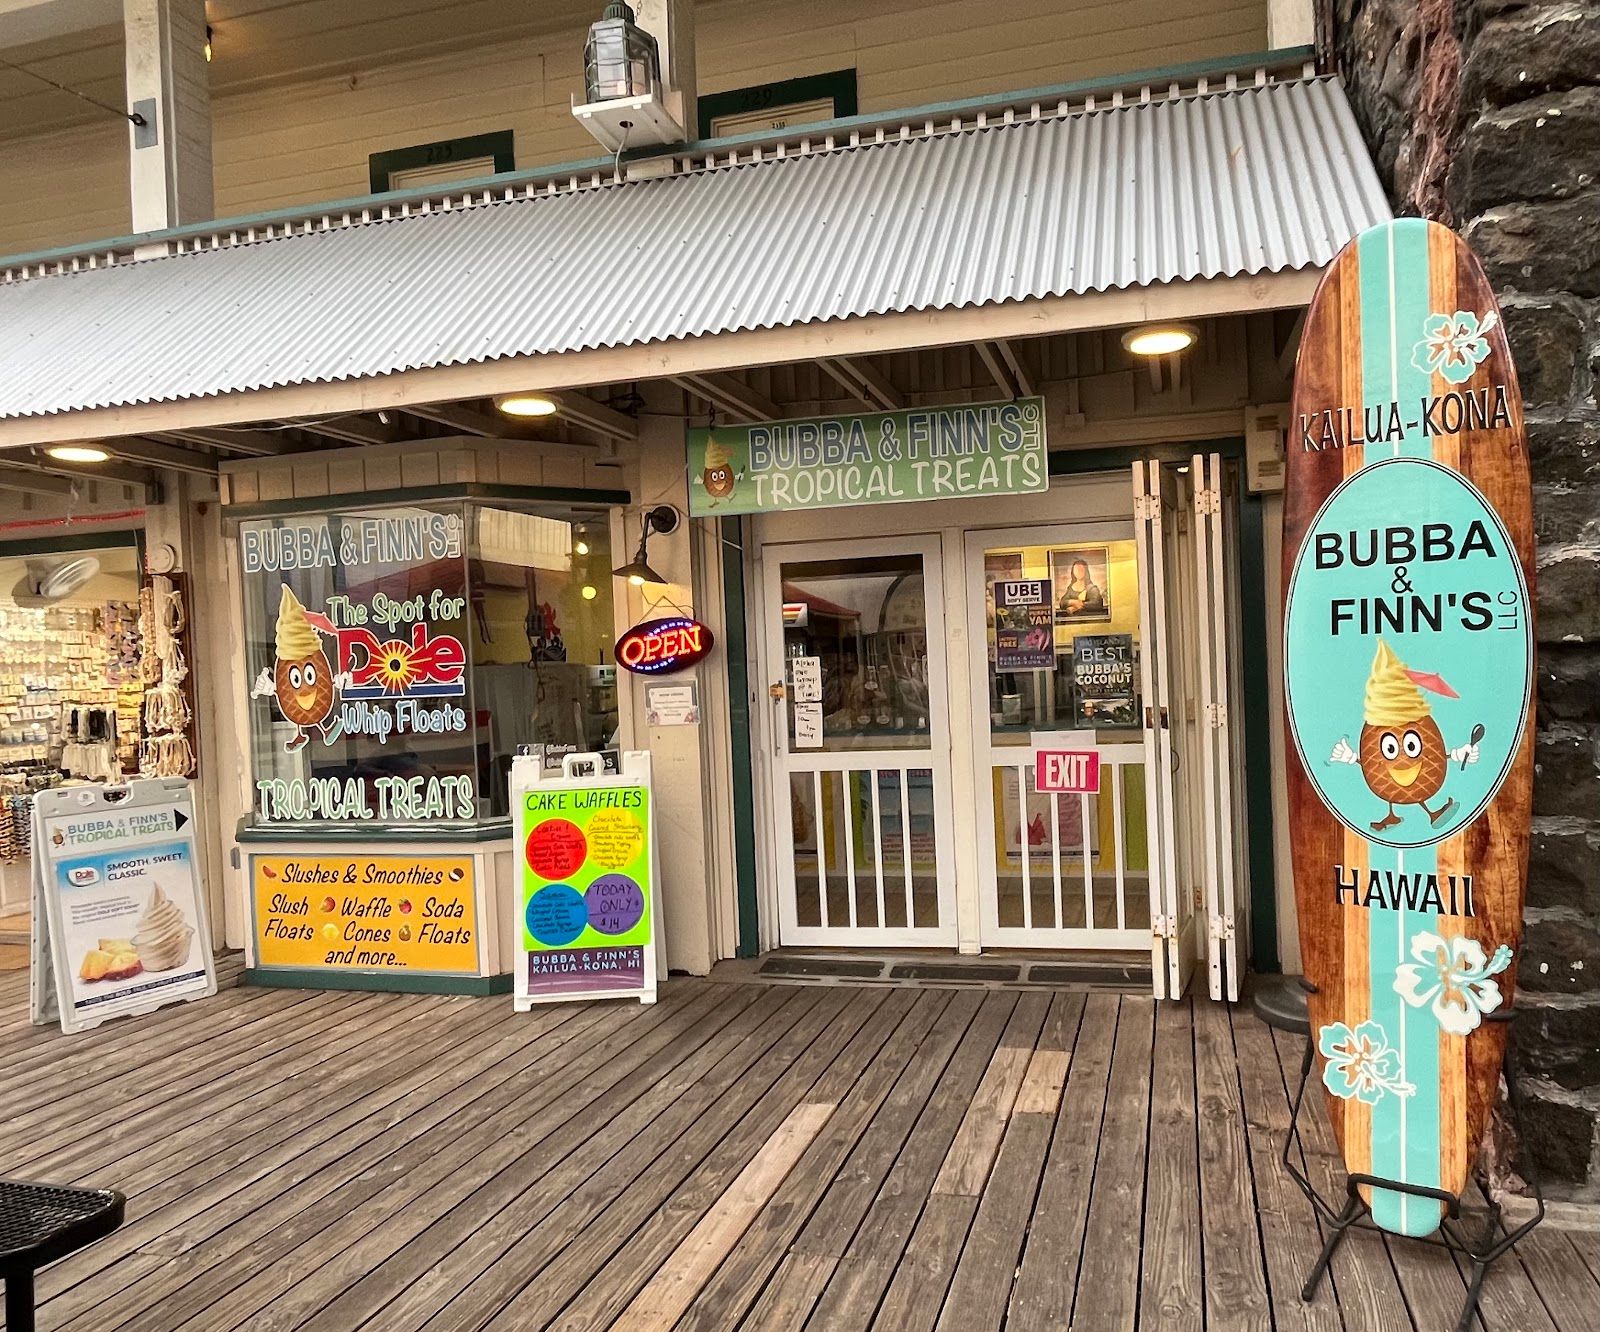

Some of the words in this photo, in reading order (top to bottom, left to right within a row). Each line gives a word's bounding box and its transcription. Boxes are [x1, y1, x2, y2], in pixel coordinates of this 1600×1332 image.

[1023, 404, 1041, 451] LLC
[1300, 385, 1513, 452] KAILUA-KONA
[749, 419, 873, 472] BUBBA
[877, 417, 902, 462] &
[908, 405, 1024, 460] FINN'S
[751, 464, 904, 506] TROPICAL
[911, 453, 1042, 495] TREATS
[243, 525, 338, 573] BUBBA
[340, 524, 359, 566] &
[361, 514, 449, 564] FINN'S
[1315, 520, 1498, 569] BUBBA
[1007, 583, 1041, 597] UBE
[1390, 566, 1414, 594] &
[326, 595, 369, 625] The
[371, 590, 424, 633] Spot
[428, 588, 465, 621] for
[1029, 616, 1051, 626] YAM
[1331, 591, 1493, 636] FINN'S
[1497, 590, 1518, 631] LLC
[338, 622, 467, 686] Dole
[621, 625, 702, 666] OPEN
[1081, 648, 1125, 661] BEST
[1076, 674, 1132, 686] COCONUT
[1077, 663, 1132, 675] BUBBA'S
[340, 704, 393, 744] Whip
[396, 699, 467, 734] Floats
[1045, 754, 1090, 788] EXIT
[257, 776, 374, 820] TROPICAL
[377, 774, 476, 820] TREATS
[526, 794, 568, 811] CAKE
[574, 790, 642, 809] WAFFLES
[67, 819, 113, 835] BUBBA
[118, 818, 125, 828] &
[128, 812, 168, 826] FINN'S
[69, 827, 130, 845] TROPICAL
[131, 821, 174, 837] TREATS
[282, 863, 339, 884] Slushes
[342, 863, 358, 884] &
[362, 863, 443, 885] Smoothies
[593, 884, 632, 896] TODAY
[1334, 865, 1476, 918] HAWAII
[268, 893, 309, 915] Slush
[341, 896, 392, 918] Waffle
[422, 896, 464, 918] Soda
[264, 918, 314, 941] Floats
[343, 920, 391, 943] Cones
[418, 923, 471, 944] Floats
[325, 945, 357, 964] and
[357, 951, 408, 966] more...
[533, 954, 576, 965] BUBBA
[582, 952, 590, 962] &
[596, 950, 640, 961] FINN'S
[628, 960, 640, 968] HI
